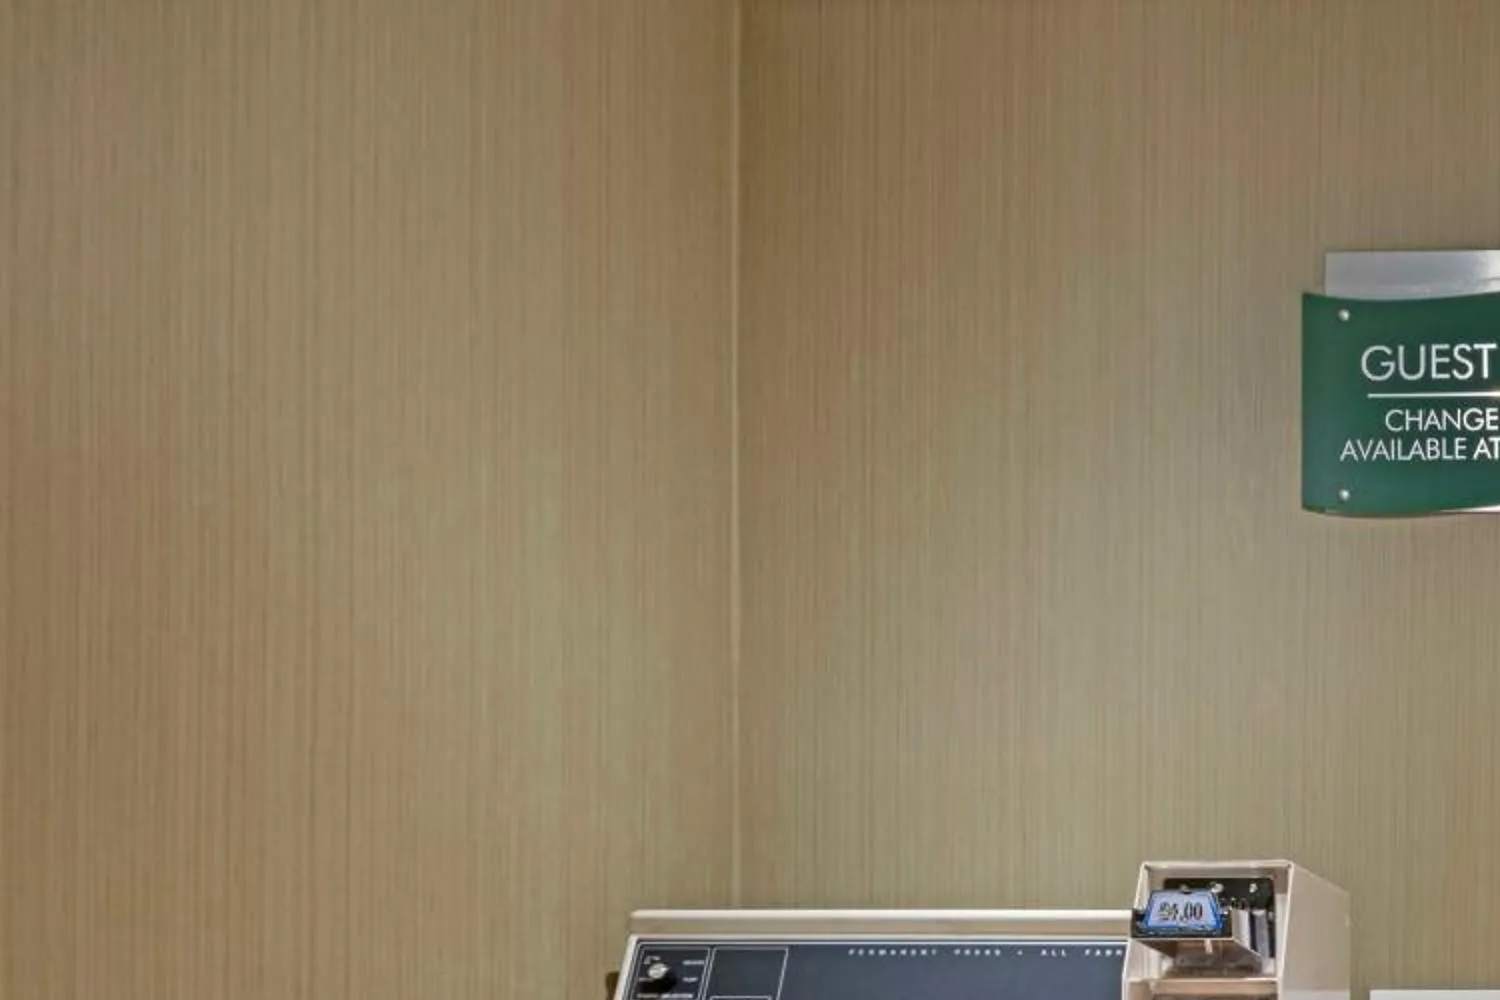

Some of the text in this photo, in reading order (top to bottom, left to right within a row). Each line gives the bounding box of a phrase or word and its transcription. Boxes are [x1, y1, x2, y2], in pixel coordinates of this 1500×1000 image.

[1361, 343, 1497, 381] GUEST
[1385, 407, 1498, 431] CHANGE
[1340, 437, 1467, 461] AVAILABLE
